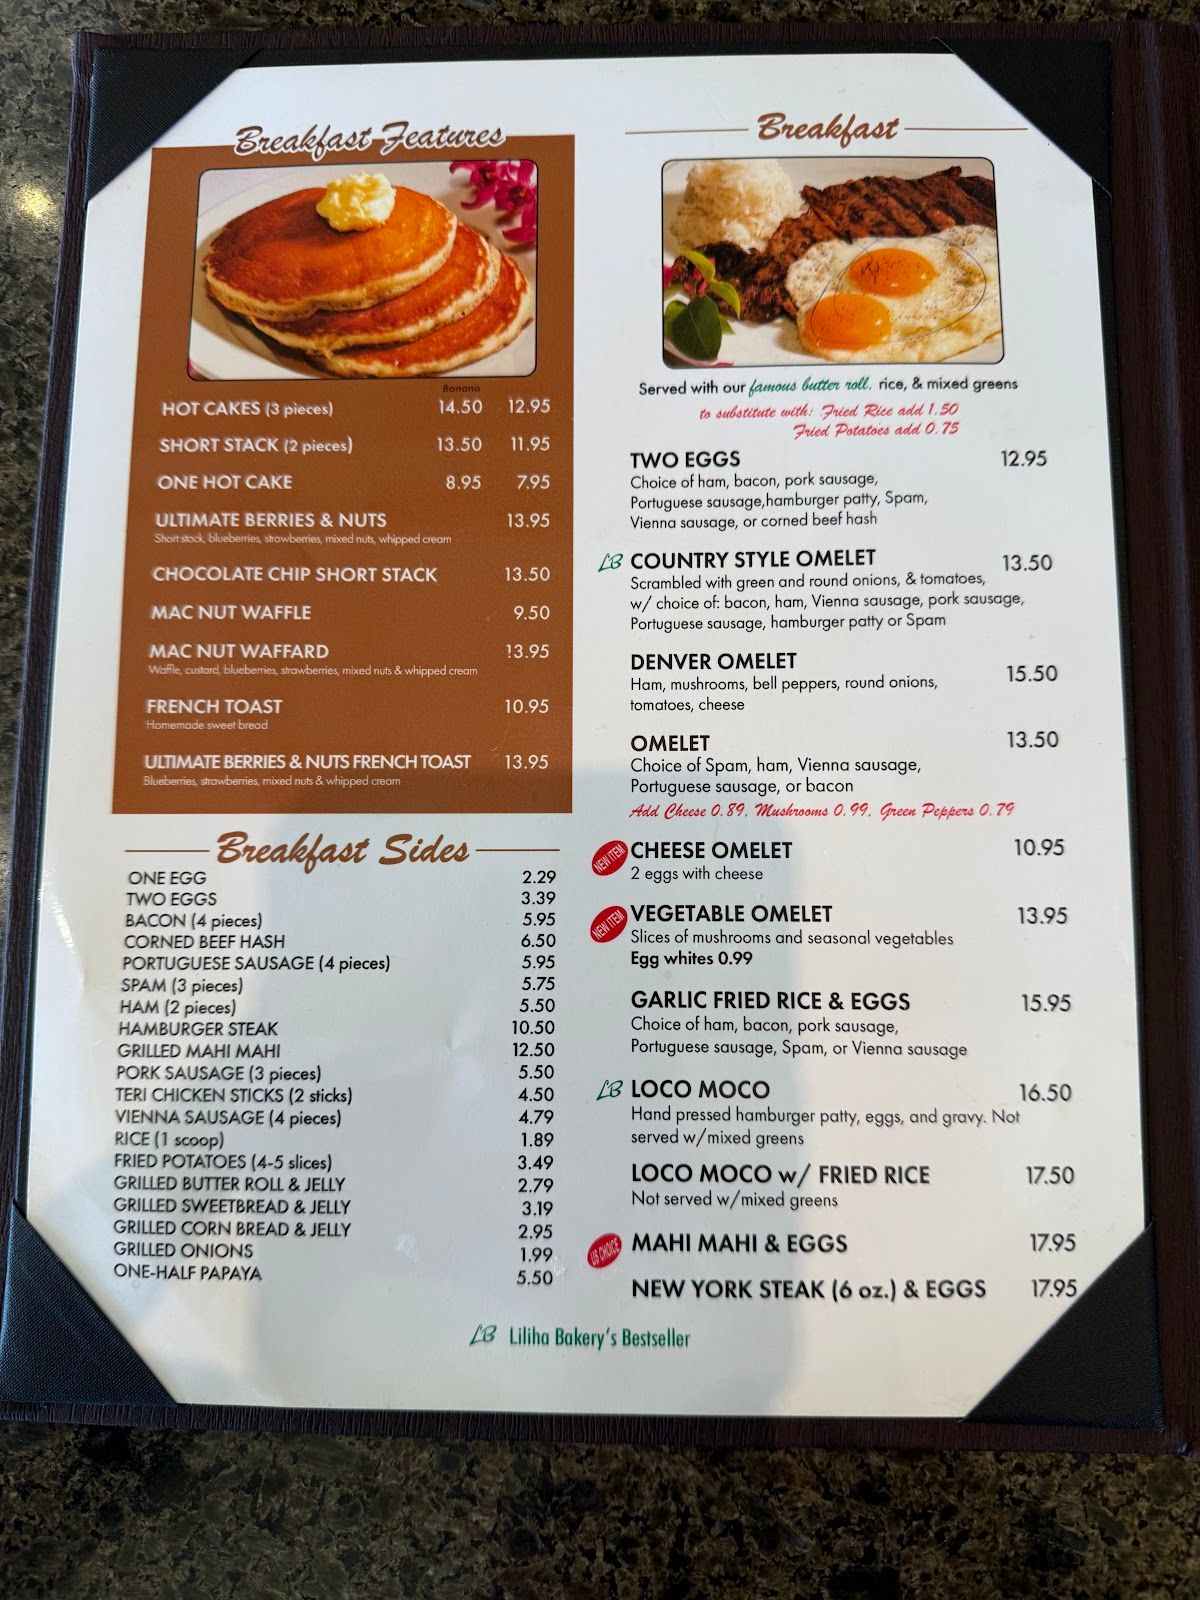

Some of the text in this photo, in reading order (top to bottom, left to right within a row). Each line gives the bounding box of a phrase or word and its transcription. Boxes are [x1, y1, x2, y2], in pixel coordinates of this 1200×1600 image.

[757, 112, 900, 149] Breakfast
[234, 120, 506, 162] Breakfast Features
[443, 384, 480, 393] Banana
[639, 380, 687, 396] Served
[690, 380, 718, 394] with
[723, 384, 746, 393] our
[748, 378, 797, 398] famous
[801, 375, 840, 392] butter
[879, 377, 907, 392] rice,
[912, 376, 923, 390] &
[927, 376, 969, 389] mixed
[973, 380, 1018, 393] greens
[162, 401, 333, 418] HOT CAKES (3 pieces)
[439, 399, 483, 414] 14.50
[509, 398, 550, 413] 12.95
[699, 401, 960, 420] to substitute with: Fried Rice add 1.50
[792, 420, 961, 440] Fried Potatoes add 0.75
[630, 450, 740, 469] TWO EGGS
[1001, 450, 1047, 467] 12.95
[157, 474, 292, 490] ONE HOT CAKE
[446, 475, 481, 490] 8.95
[517, 474, 550, 489] 7.95
[630, 471, 878, 490] Choice of ham, bacon, pork sausage,
[631, 549, 876, 569] COUNTRY STYLE OMELET
[1002, 554, 1053, 571] 13.50
[152, 566, 437, 582] CHOCOLATE CHIP SHORT STACK
[505, 566, 550, 582] 13.50
[151, 605, 311, 620] MAC NUT WAFFLE
[514, 605, 550, 620] 9.50
[631, 652, 797, 670] DENVER OMELET
[148, 663, 478, 678] Waffle, custard, blueberries, strawberries, mixed nuts & whipped cream
[1007, 665, 1058, 682] 15.50
[147, 699, 283, 714] FRENCH TOAST
[505, 699, 549, 714] 10.95
[630, 696, 745, 713] tomatoes, cheese
[146, 719, 268, 730] Homemade sweet bread
[631, 735, 710, 752] OMELET
[1007, 731, 1059, 748] 13.50
[629, 803, 660, 818] Add
[664, 802, 707, 820] Cheese
[754, 802, 828, 818] Mushrooms
[880, 802, 916, 821] Green
[921, 802, 974, 820] Peppers
[979, 802, 1015, 817] 0.79
[216, 830, 470, 874] Breakfast Sides
[631, 841, 793, 859] CHEESE OMELET
[1014, 838, 1064, 856] 10.95
[593, 843, 626, 873] NEW ITEM
[128, 871, 207, 885] ONE EGG
[522, 870, 556, 884] 2.29
[631, 865, 763, 884] 2 eggs with cheese
[125, 912, 262, 931] BACON (4 pieces)
[522, 912, 555, 926] 5.95
[630, 904, 833, 922] VEGETABLE OMELET
[1018, 907, 1067, 925] 13.95
[591, 909, 625, 941] NEW ITEM
[124, 934, 285, 949] CORNED BEEF HASH
[521, 933, 556, 948] 6.50
[631, 950, 753, 969] Egg whites 0.99
[119, 1022, 279, 1036] HAMBURGER STEAK
[512, 1020, 555, 1035] 10.50
[117, 1043, 280, 1058] GRILLED MAHI MAHI
[513, 1042, 555, 1057] 12.50
[632, 1079, 770, 1099] LOCO MOCO
[1019, 1083, 1072, 1102] 16.50
[115, 1130, 224, 1151] RICE (1 scoop)
[521, 1132, 554, 1147] 1.89
[113, 1241, 253, 1259] GRILLED ONIONS
[632, 1233, 848, 1253] MAHI MAHI & EGGS
[1030, 1233, 1076, 1252] 17.95
[521, 1247, 553, 1262] 1.99
[113, 1263, 262, 1281] ONE-HALF PAPAYA
[516, 1270, 553, 1285] 5.50
[509, 1325, 550, 1346] Liliha
[554, 1327, 618, 1350] Bakery's
[621, 1328, 692, 1348] Bestseller
